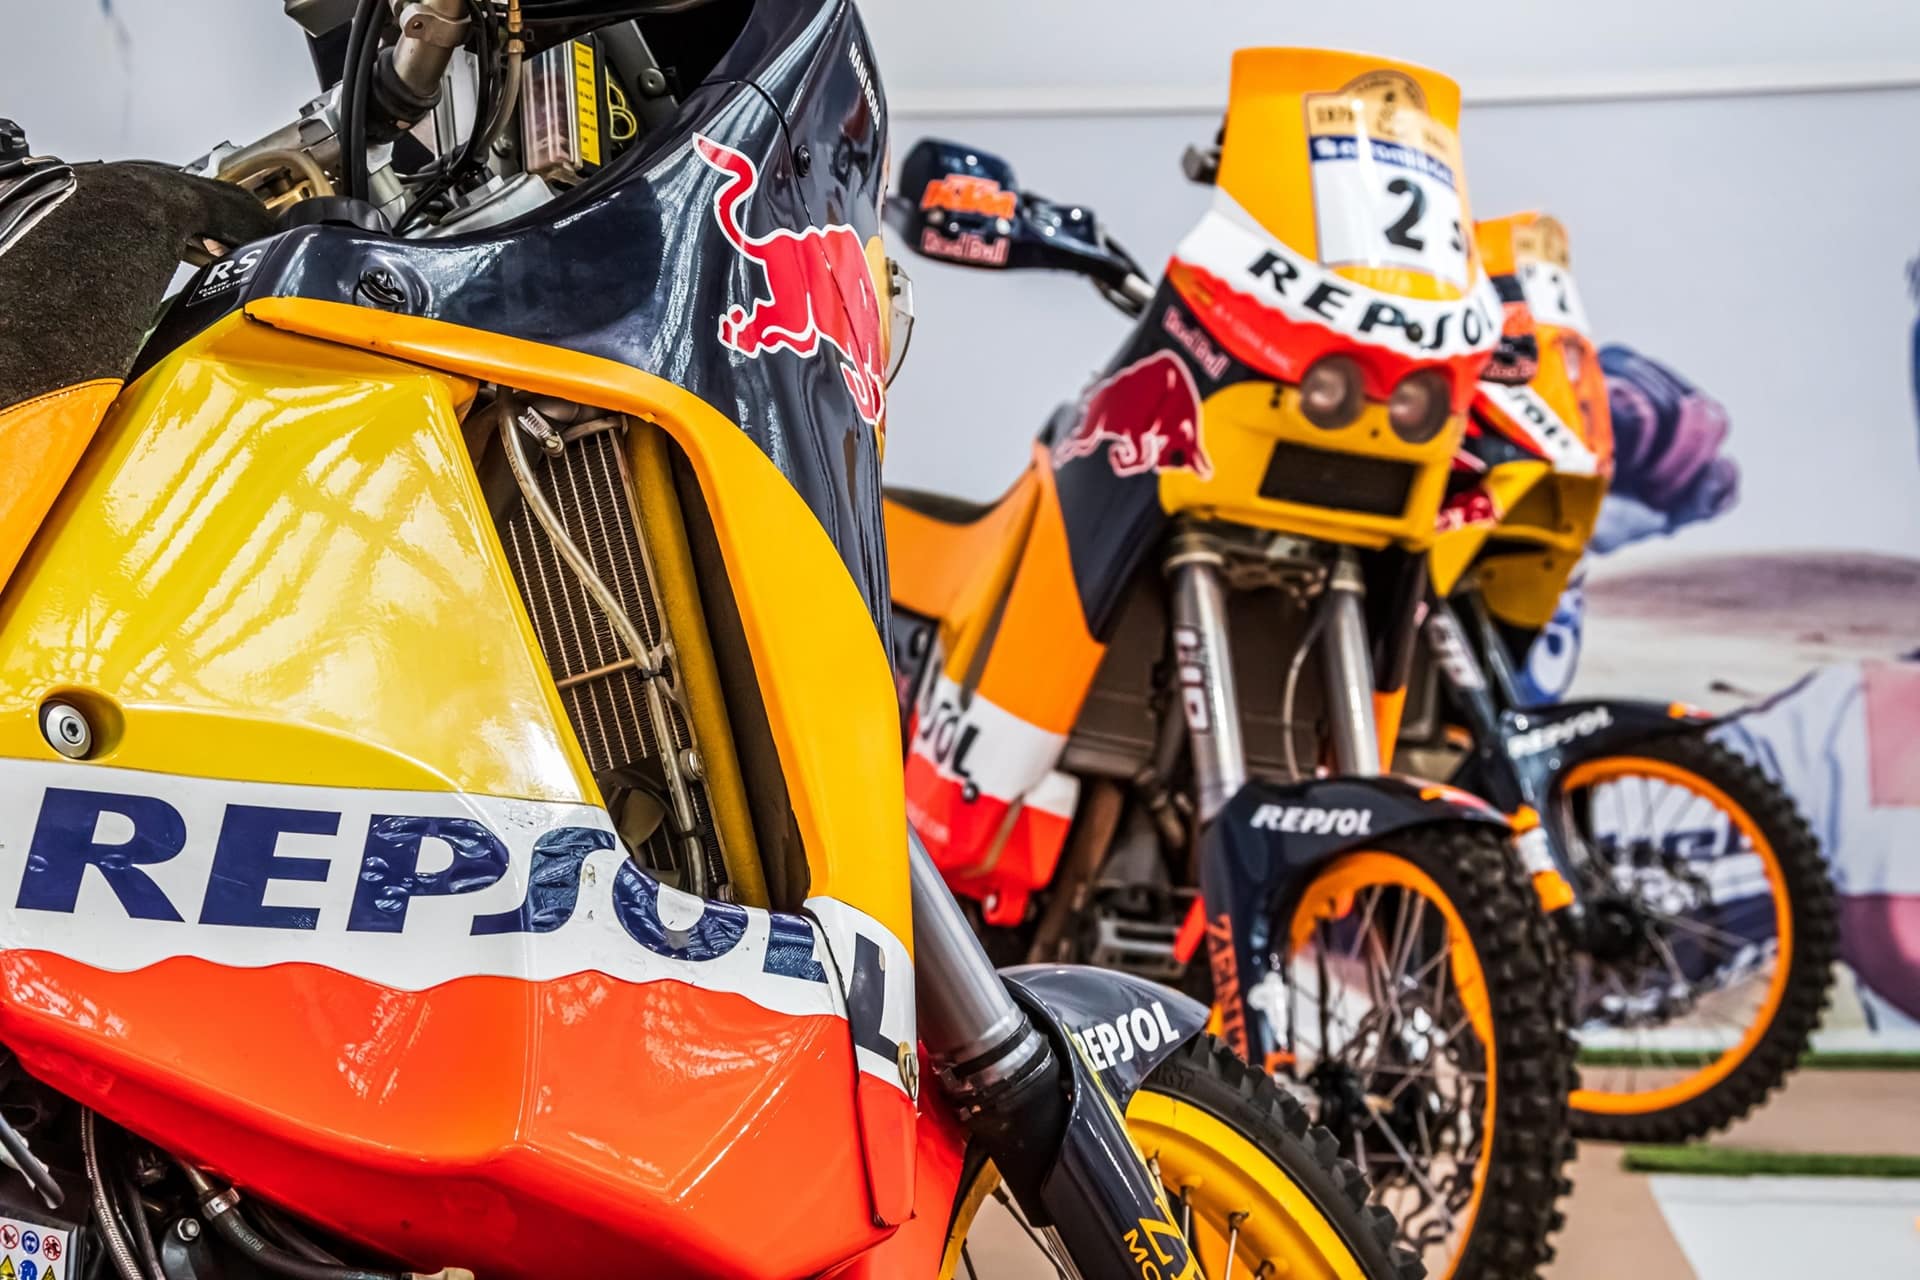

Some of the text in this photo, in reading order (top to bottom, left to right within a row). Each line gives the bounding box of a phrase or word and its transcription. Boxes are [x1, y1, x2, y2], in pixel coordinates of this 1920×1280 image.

[1384, 175, 1427, 251] 2
[203, 249, 262, 286] RS
[1250, 803, 1372, 836] REPSOL
